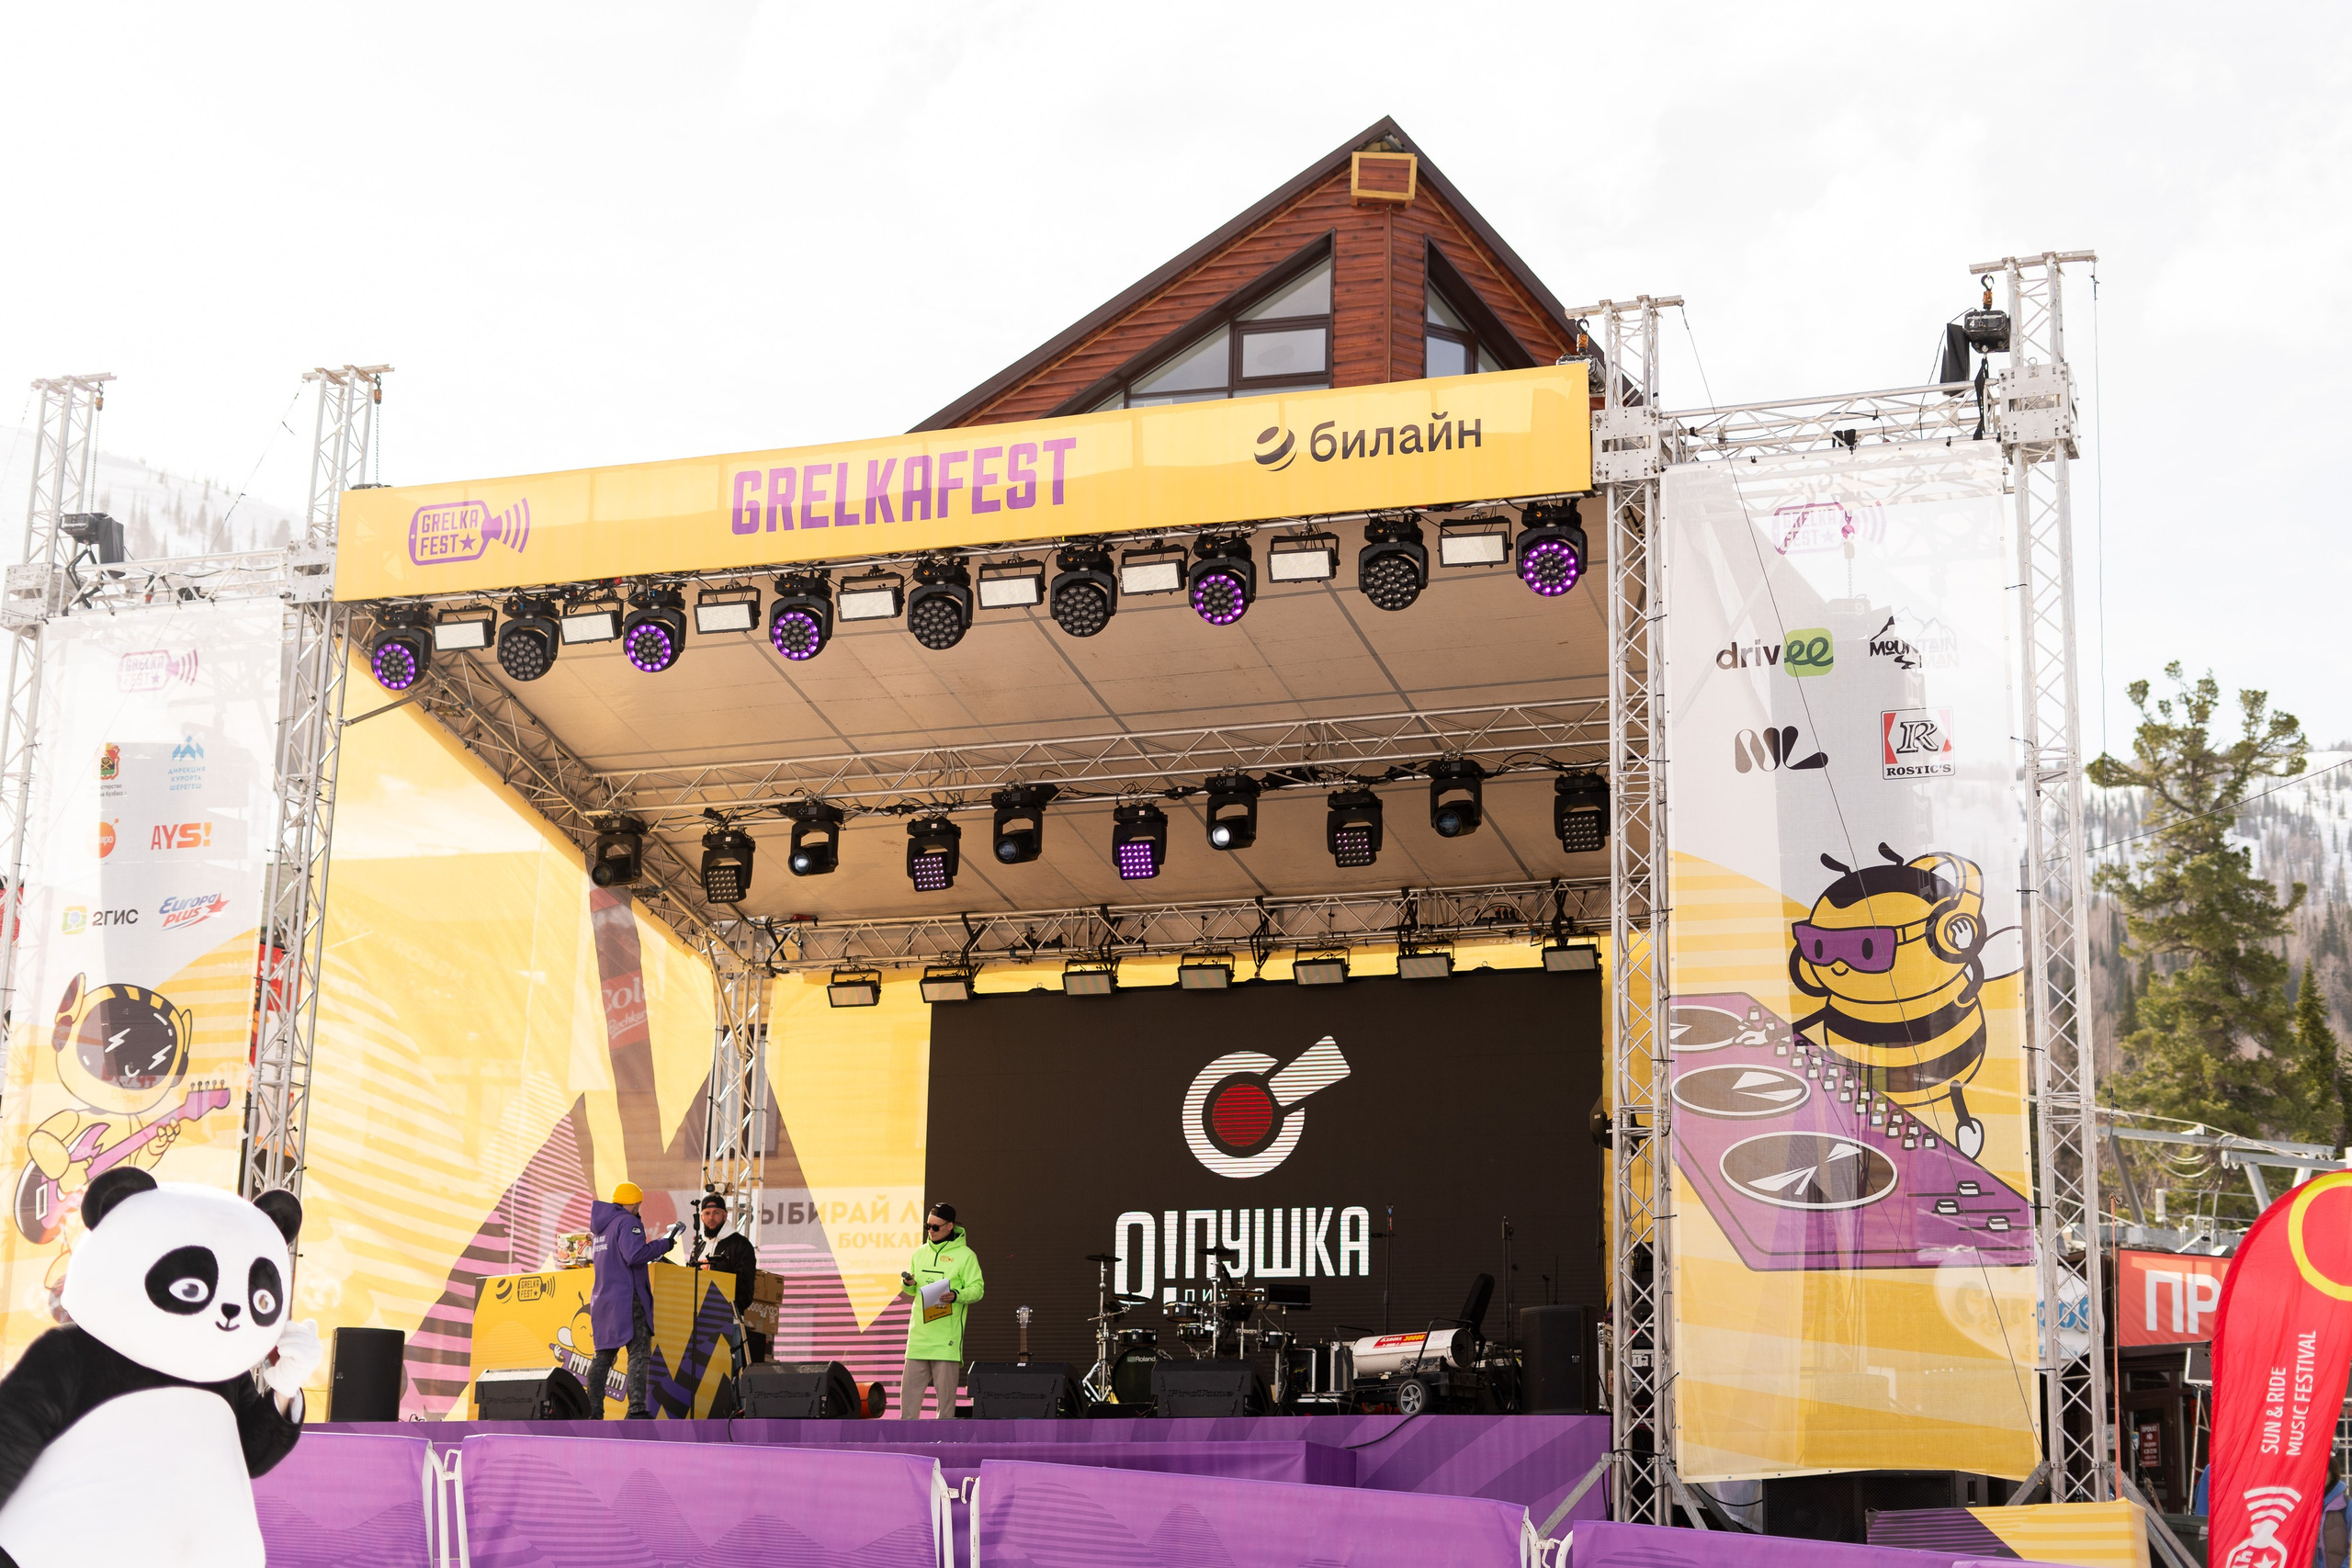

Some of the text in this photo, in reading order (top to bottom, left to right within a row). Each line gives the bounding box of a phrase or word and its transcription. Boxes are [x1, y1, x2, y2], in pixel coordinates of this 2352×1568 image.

[1310, 411, 1482, 463] билайн
[731, 437, 1077, 536] GRELKAFEST
[422, 509, 479, 533] GRELKA
[1782, 508, 1837, 529] GRELKA
[420, 534, 459, 557] FEST
[1783, 529, 1820, 547] FEST
[1715, 637, 1834, 670] drivee
[125, 656, 164, 671] GRELKA
[123, 671, 151, 686] FEST
[167, 765, 206, 774] ДИРЕКЦИЯ
[1886, 762, 1951, 777] ROSTIC'S
[169, 783, 202, 791] ШЕРЕГЕШ
[151, 822, 212, 850] AYS!
[92, 909, 139, 927] 2ГИС
[738, 1193, 890, 1225] ВЫБИРАЙ
[520, 1289, 534, 1298] FEST
[521, 1279, 540, 1290] GRELKA
[1404, 1334, 1425, 1342] 30000
[2286, 1330, 2316, 1456] MUSIC FESTIVAL
[2261, 1366, 2287, 1455] SUN & RIDE
